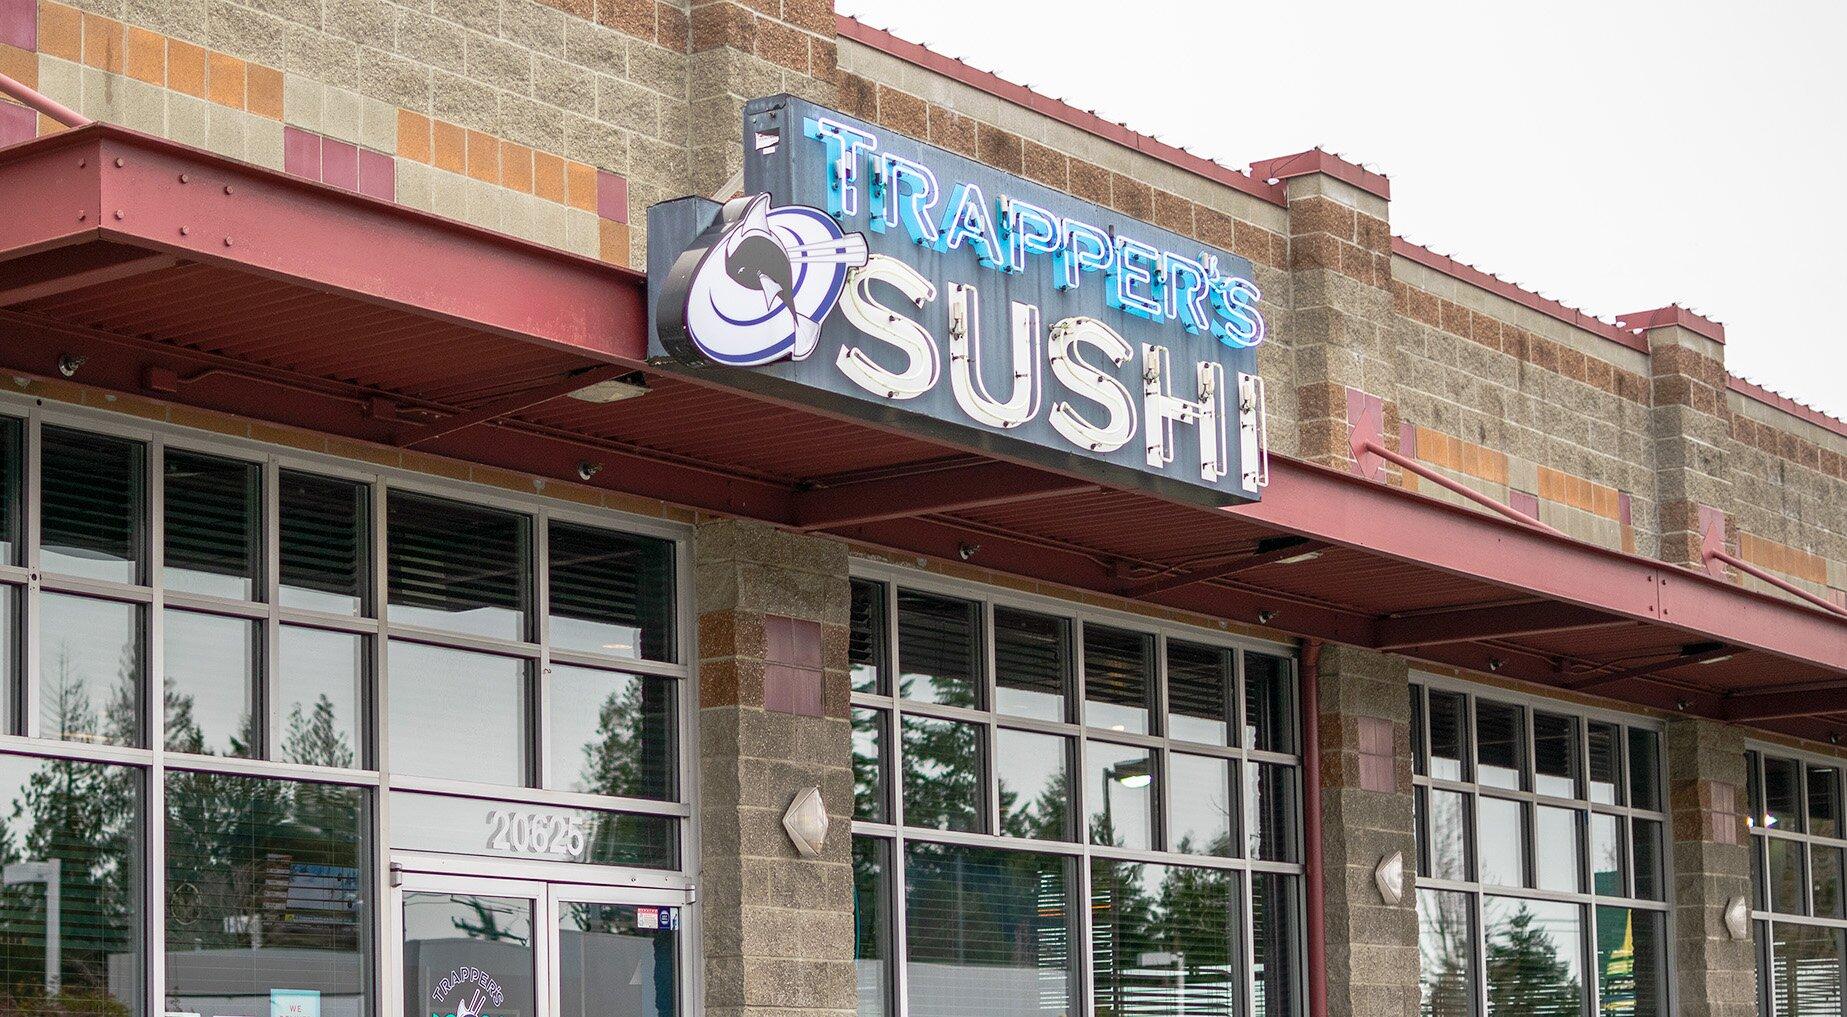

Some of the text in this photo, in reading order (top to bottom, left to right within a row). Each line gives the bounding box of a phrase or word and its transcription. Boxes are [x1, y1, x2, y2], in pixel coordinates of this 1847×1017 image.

[804, 116, 1265, 348] TRAPPER'S
[836, 254, 1270, 493] SUSHI
[486, 810, 584, 856] 20625
[432, 966, 504, 1007] TRAPPER'S
